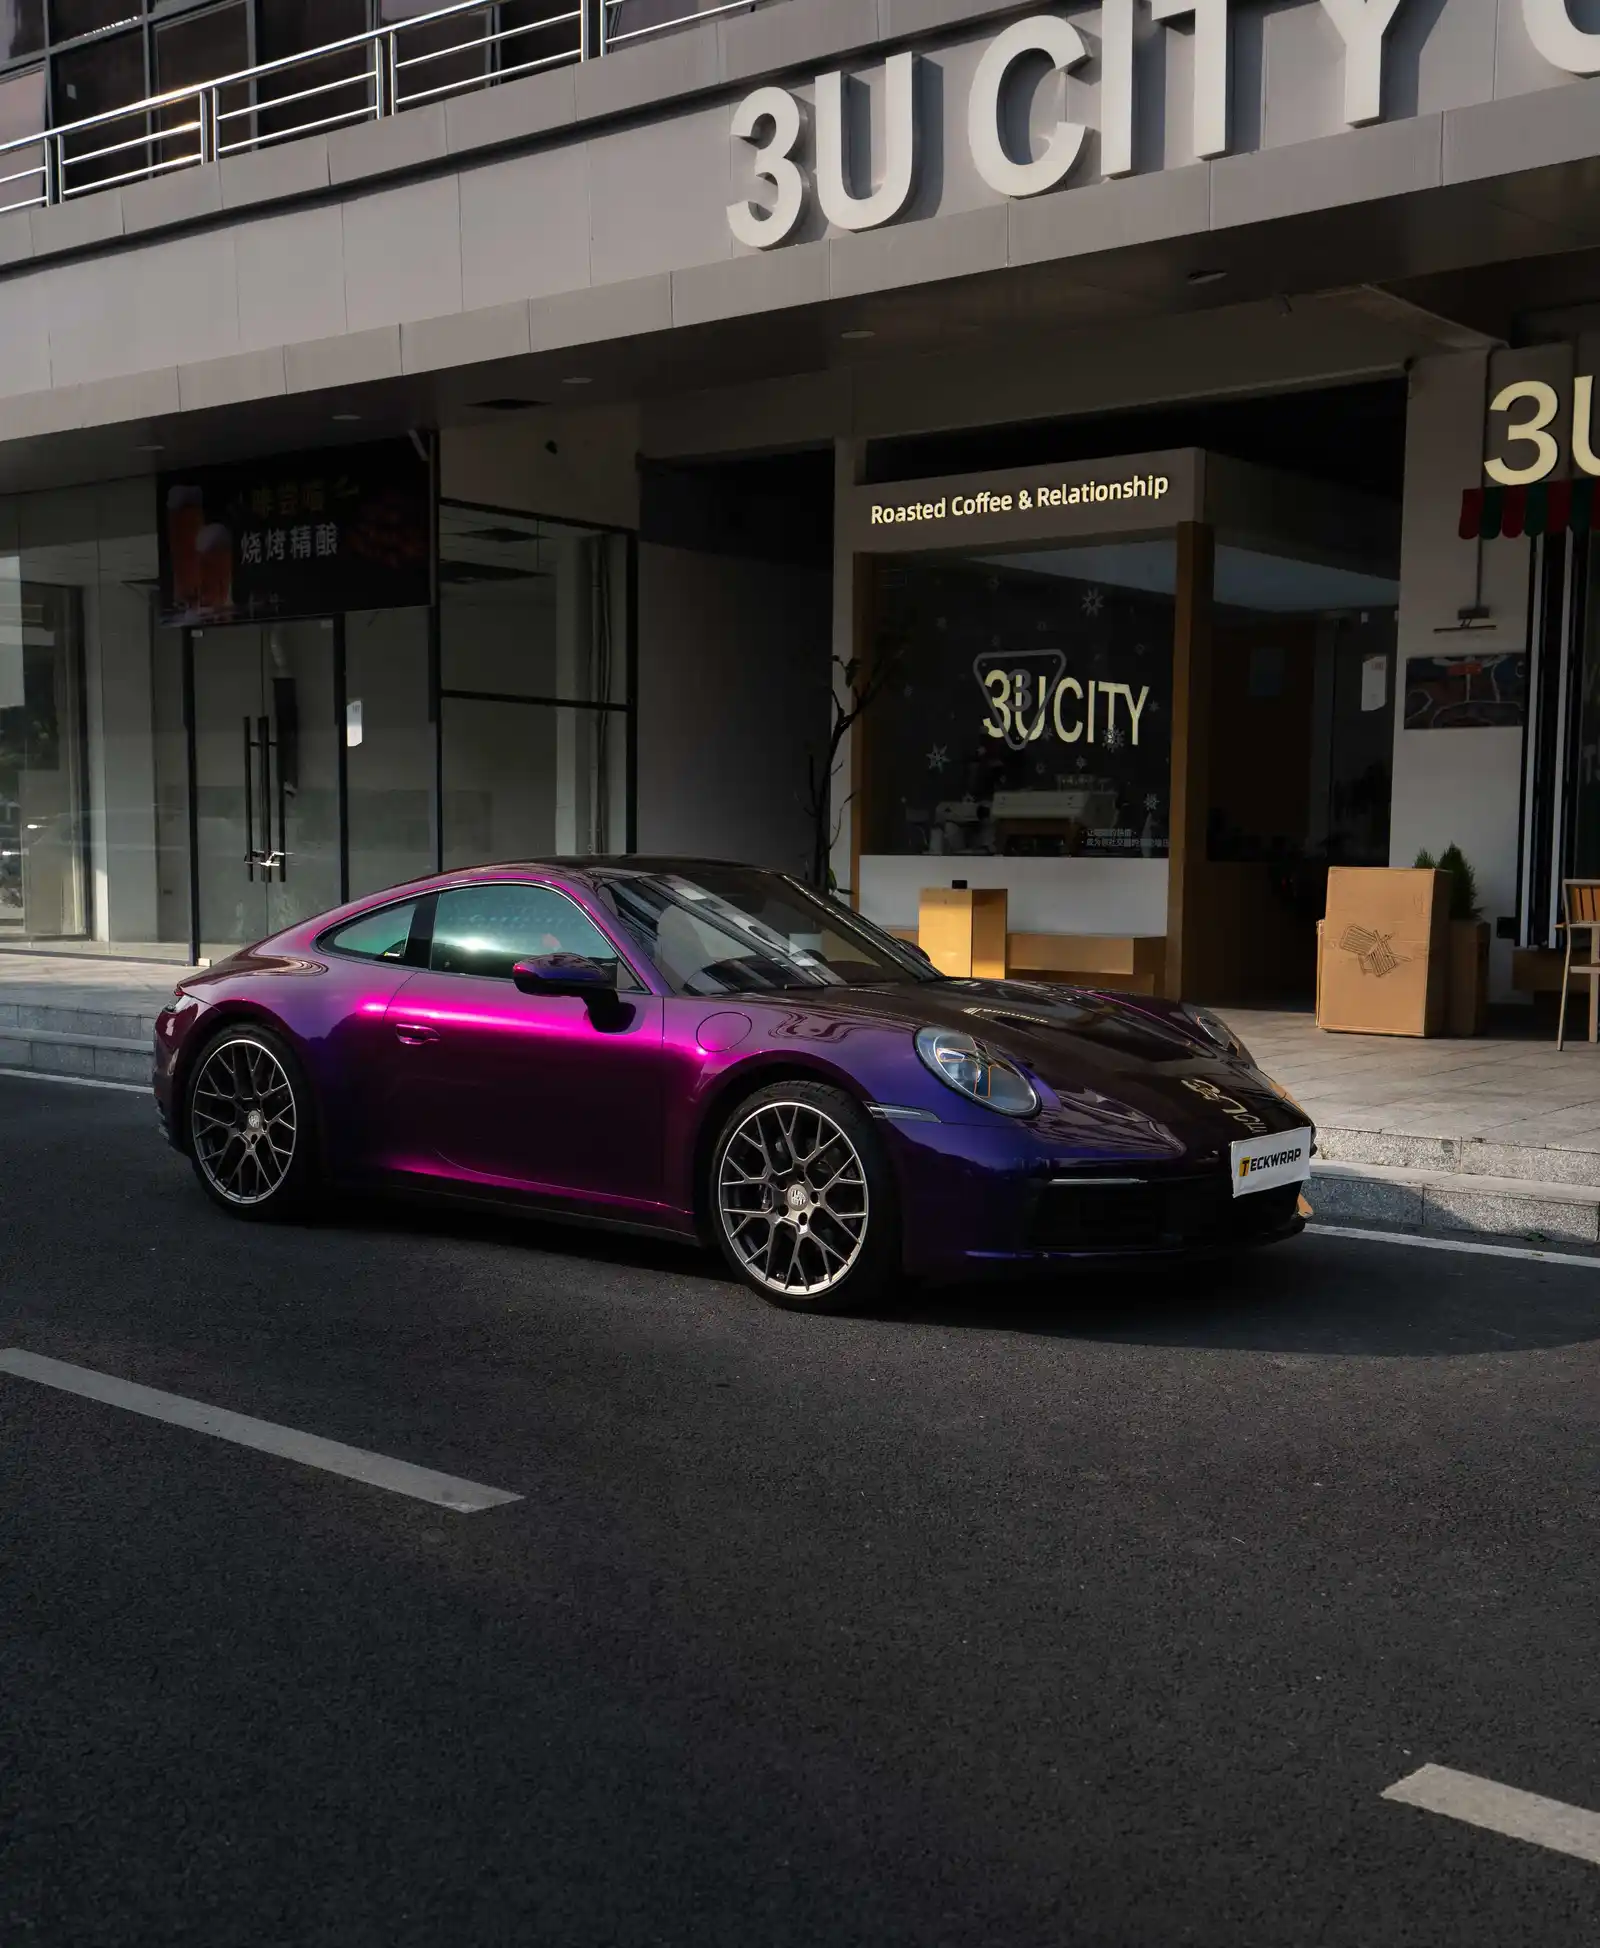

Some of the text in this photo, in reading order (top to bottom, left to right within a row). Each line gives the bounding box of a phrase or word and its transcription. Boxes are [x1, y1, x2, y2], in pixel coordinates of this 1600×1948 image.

[726, 0, 1401, 248] 3U CITY
[870, 474, 1169, 525] Roasted Coffee & Relationship
[1241, 1147, 1302, 1177] TECKWRAP
